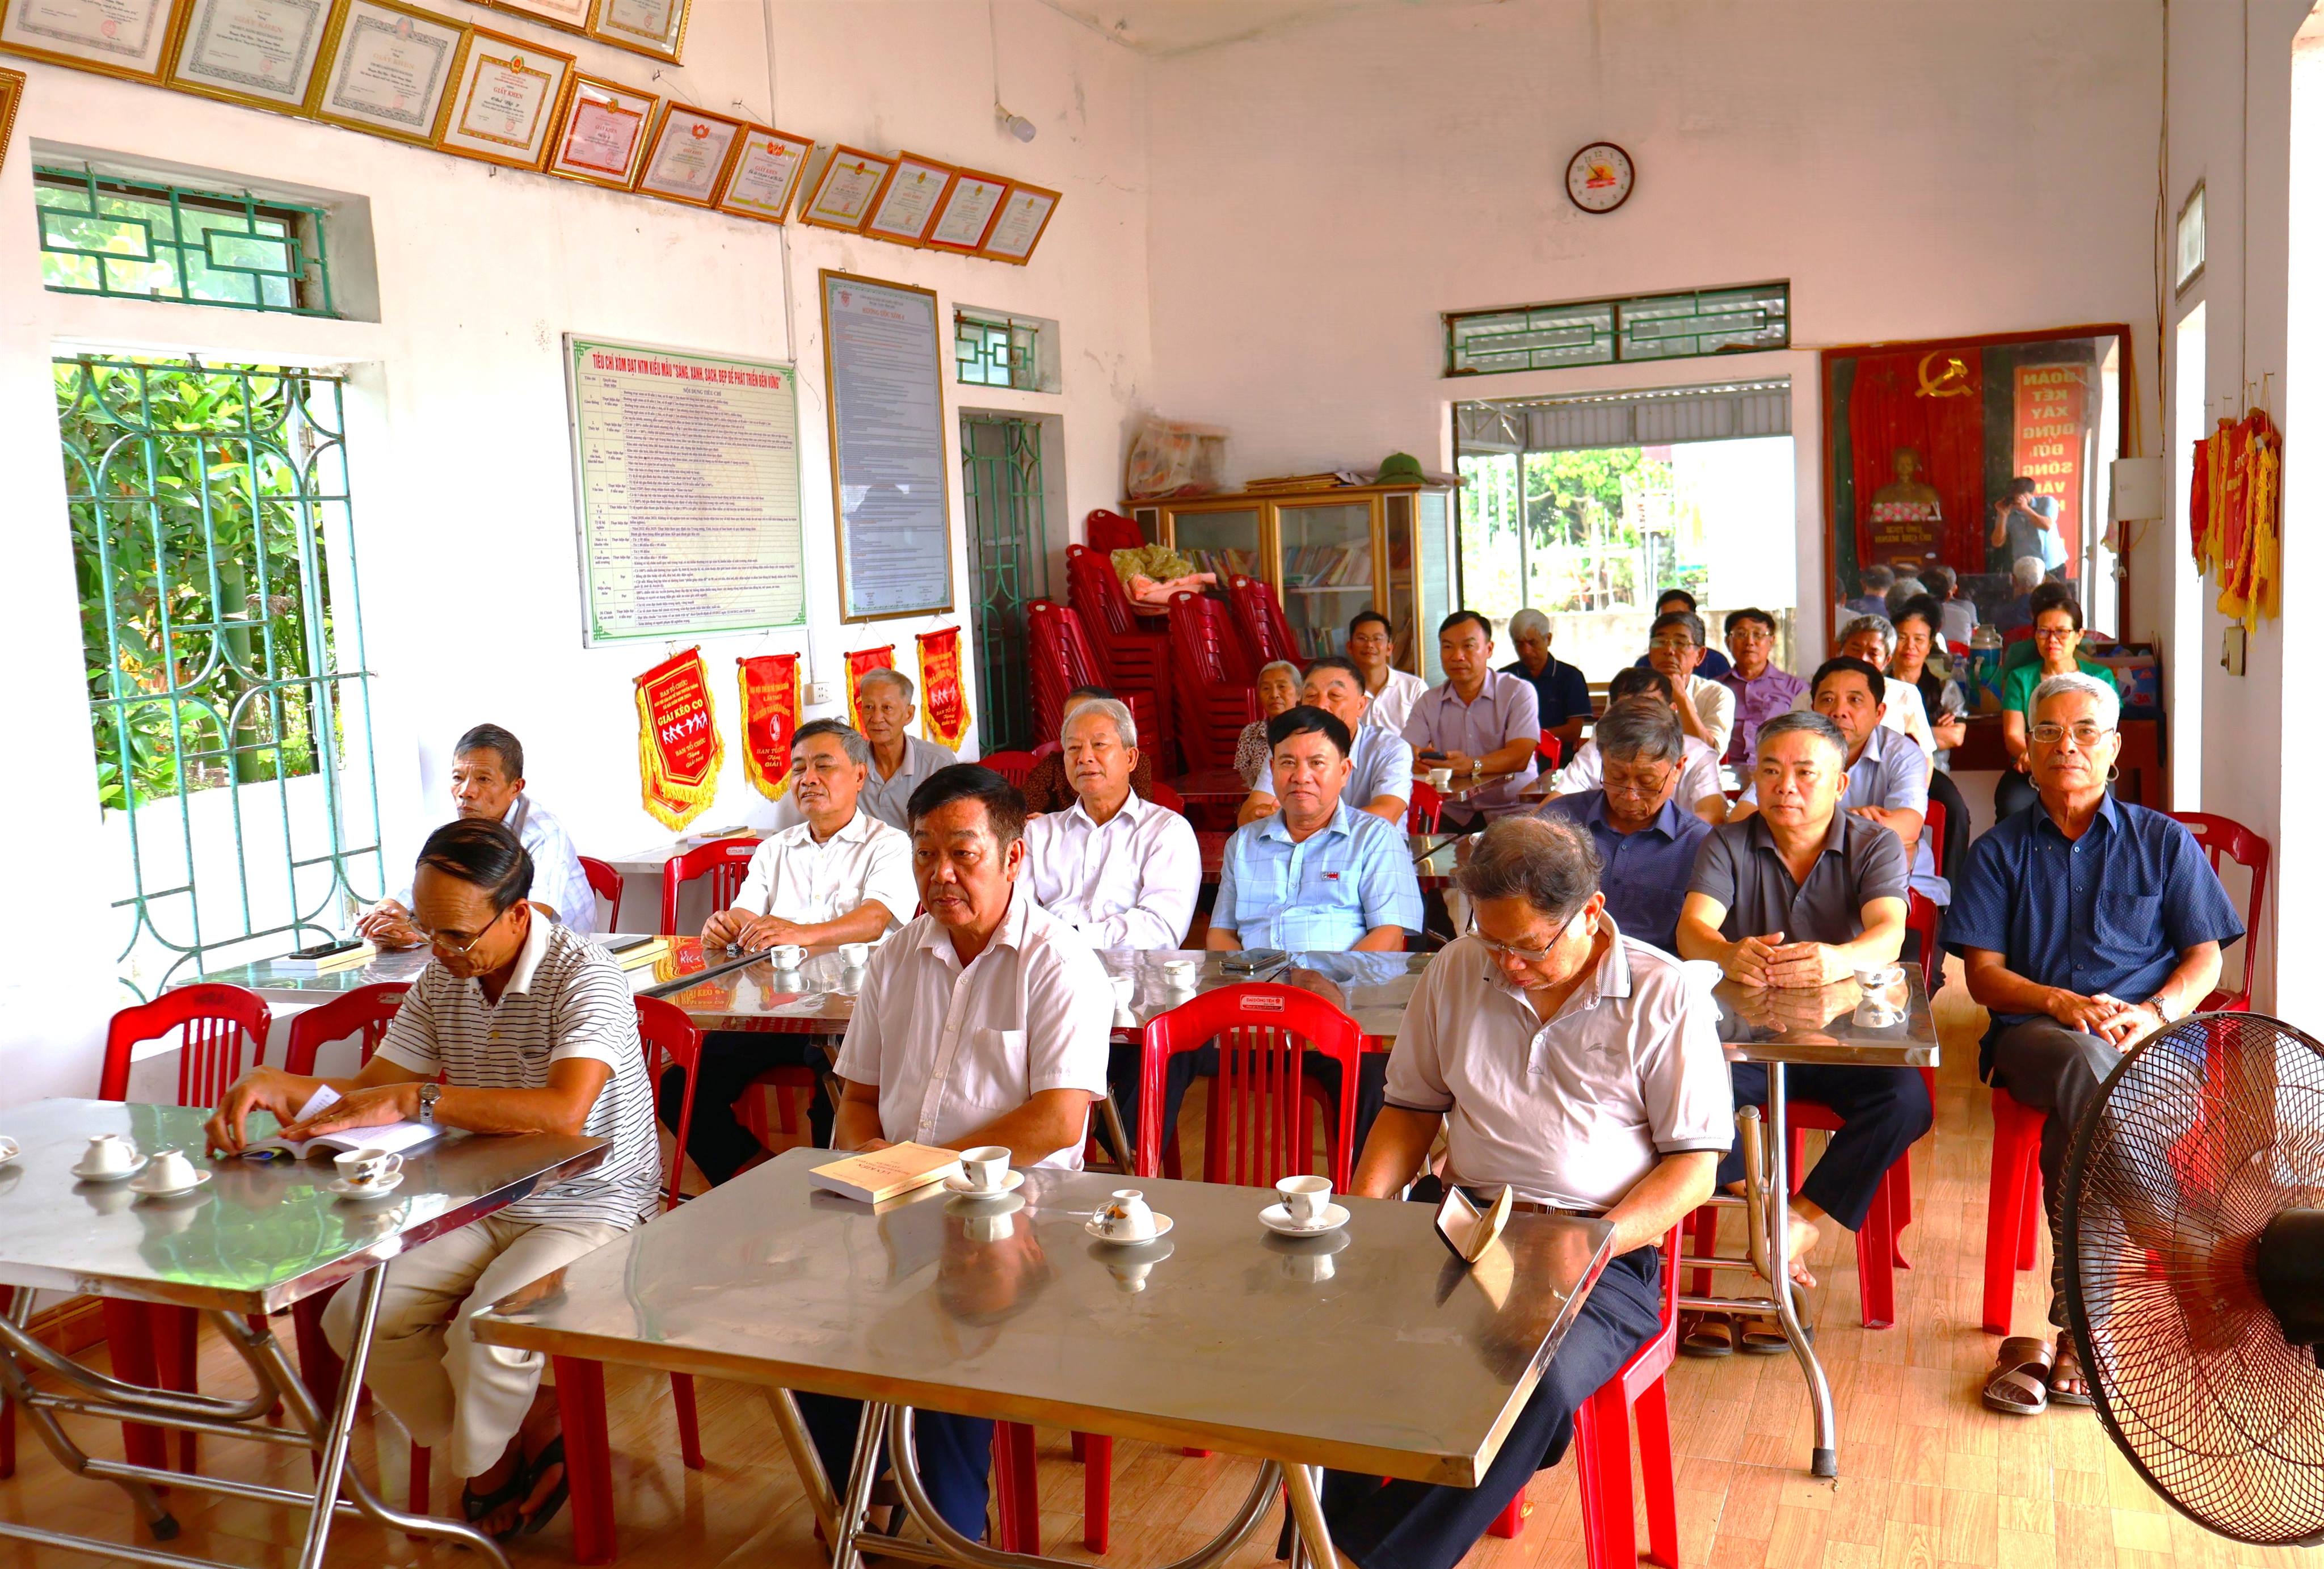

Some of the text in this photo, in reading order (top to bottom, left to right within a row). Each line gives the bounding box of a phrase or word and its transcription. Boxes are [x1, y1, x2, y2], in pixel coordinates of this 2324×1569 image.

[508, 91, 523, 99] KHEN
[592, 352, 604, 369] TIÊU
[605, 353, 614, 370] CHÍ
[614, 355, 626, 372] XÓM
[628, 359, 637, 376] ĐẠT
[638, 360, 649, 375] NTM
[649, 356, 660, 376] KIỂU
[690, 366, 704, 382] XANH,
[705, 368, 718, 384] SẠCH,
[735, 369, 745, 385] PHÁT
[660, 679, 688, 698] BAN TỔ CHỨC
[658, 699, 703, 726] GIẢI KÉO CO
[675, 737, 706, 757] BAN TỔ CHỨC
[685, 759, 695, 768] GIẢI
